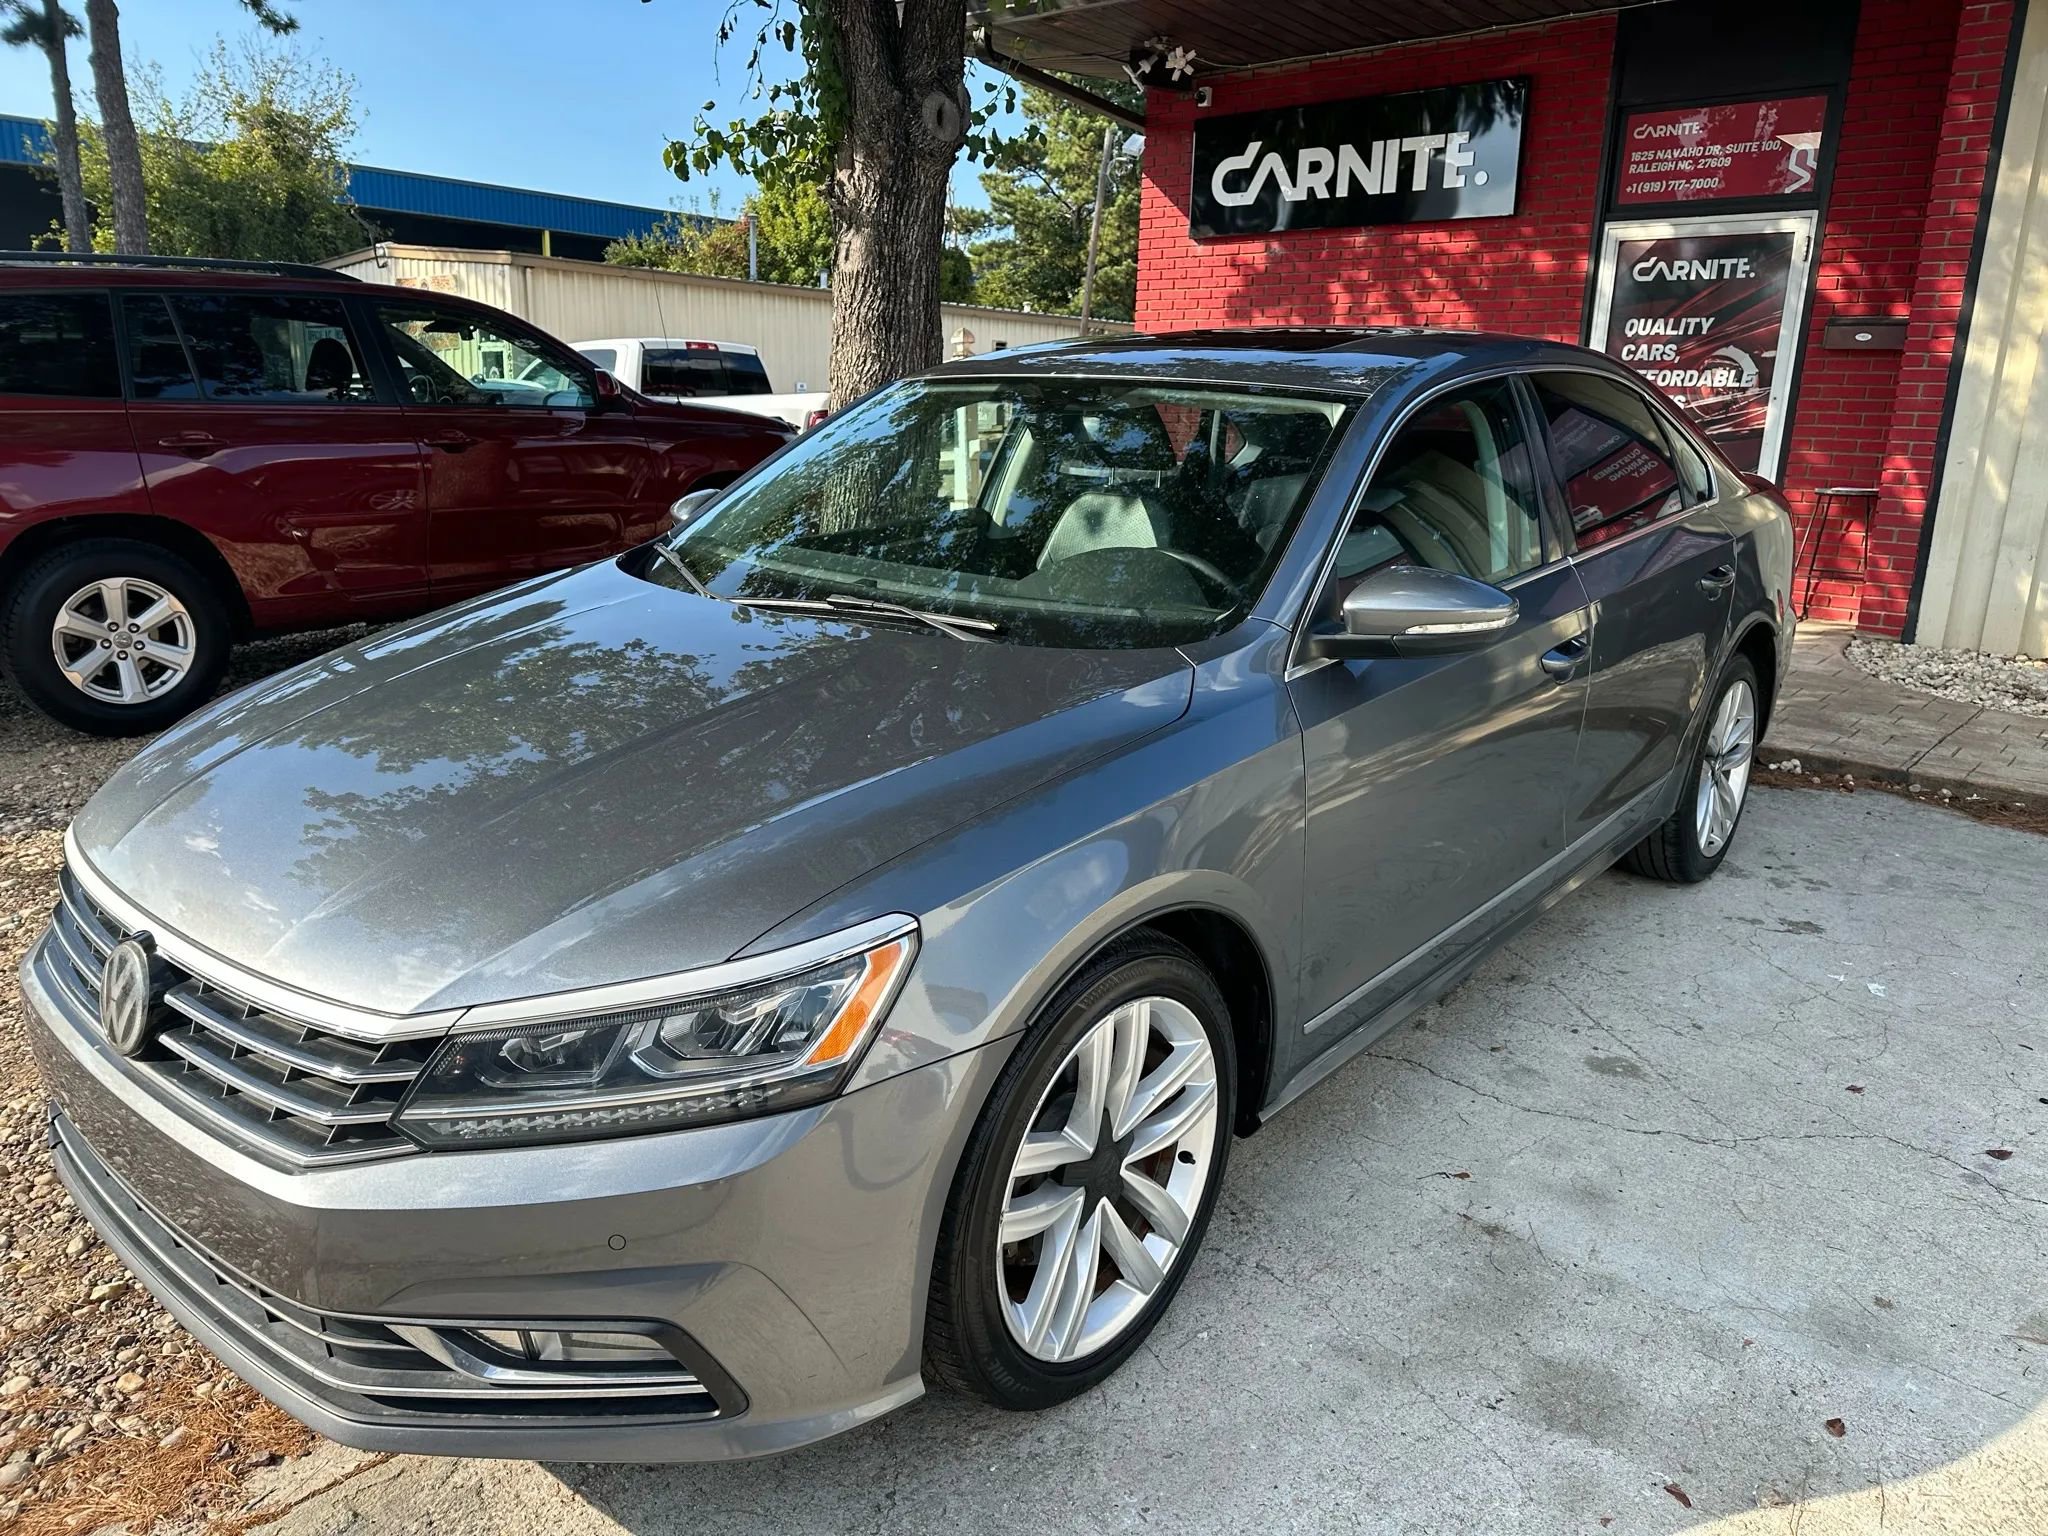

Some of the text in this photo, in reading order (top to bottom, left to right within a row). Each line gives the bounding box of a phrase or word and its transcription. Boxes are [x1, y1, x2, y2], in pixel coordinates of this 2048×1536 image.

[1631, 139, 1783, 162] 1625 NAVAHO DR, SUITE 100,
[1629, 156, 1732, 174] RALEIGH NC, 27609
[1668, 177, 1719, 191] 717-7000
[1624, 317, 1715, 338] QUALITY
[1621, 343, 1681, 364] CARS,
